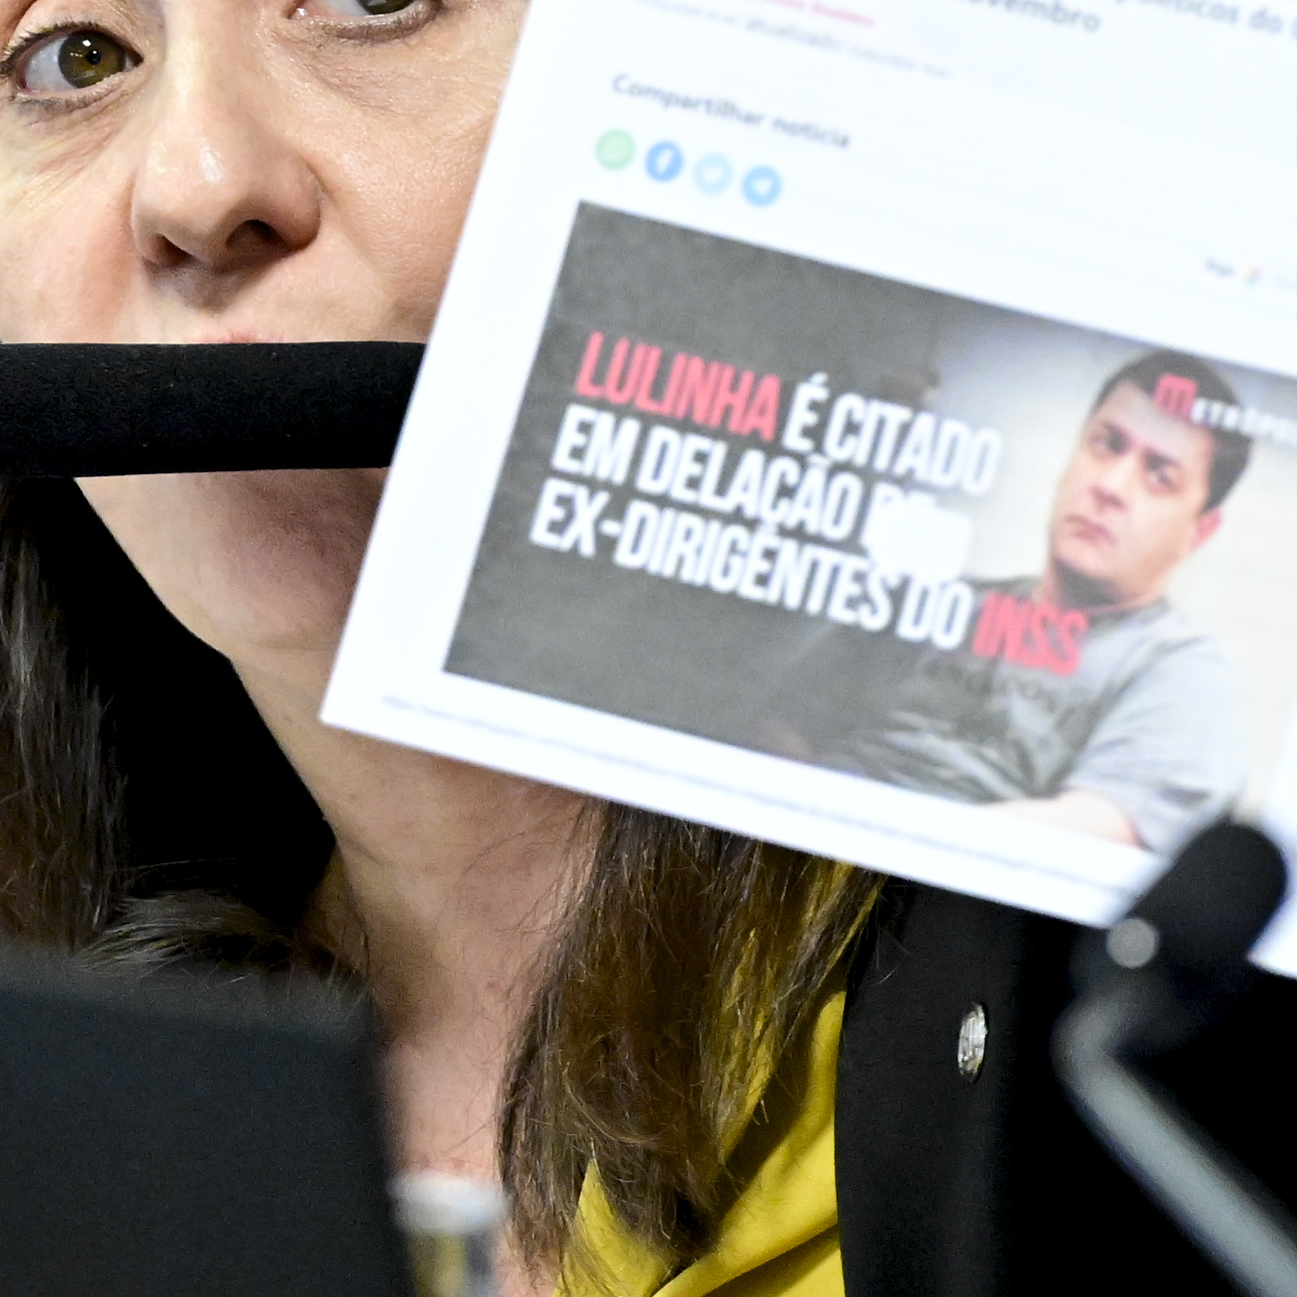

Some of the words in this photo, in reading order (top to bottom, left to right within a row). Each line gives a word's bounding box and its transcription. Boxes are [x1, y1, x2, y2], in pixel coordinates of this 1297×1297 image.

[1247, 5, 1285, 37] do
[610, 72, 765, 128] Compartilhar
[550, 404, 642, 485] EM
[636, 422, 863, 544] DELAÇÃO
[574, 330, 782, 443] LULINHA
[782, 372, 830, 452] É
[824, 392, 1004, 498] CITADO
[529, 478, 894, 633] EX-DIRIGENTES
[896, 572, 976, 650] DO
[971, 590, 1089, 677] INSS
